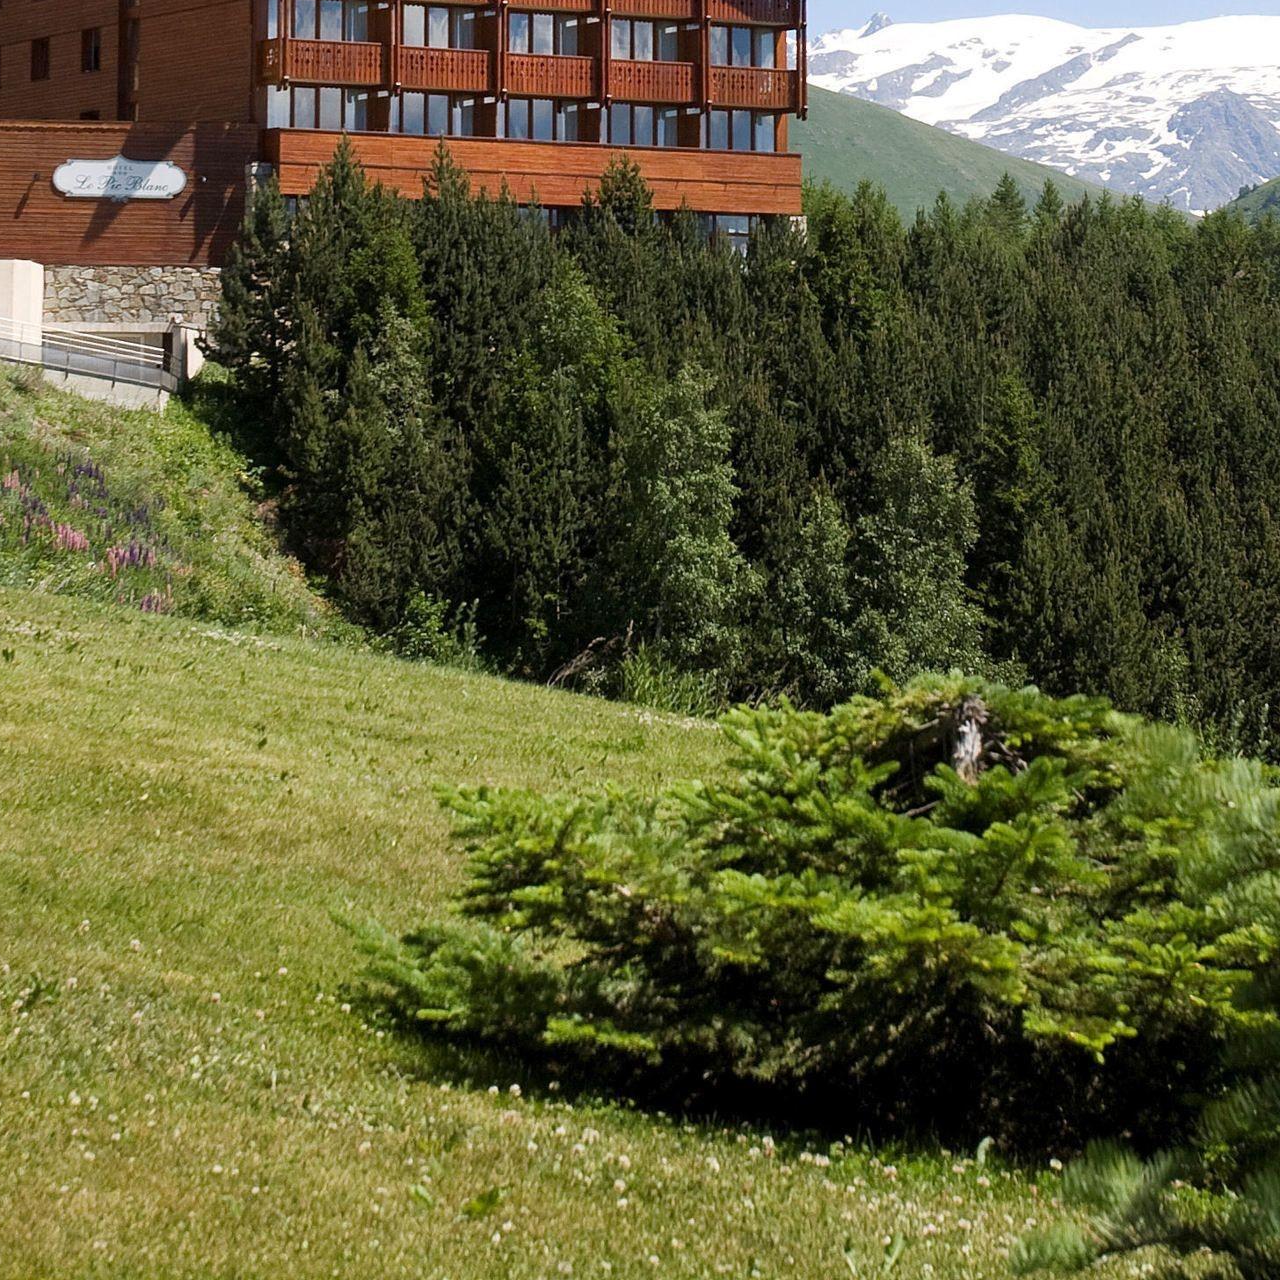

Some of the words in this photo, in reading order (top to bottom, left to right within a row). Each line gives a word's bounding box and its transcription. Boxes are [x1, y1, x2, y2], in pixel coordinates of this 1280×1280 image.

[73, 174, 94, 190] Le
[97, 175, 122, 190] Pic
[125, 175, 169, 191] Blanc
